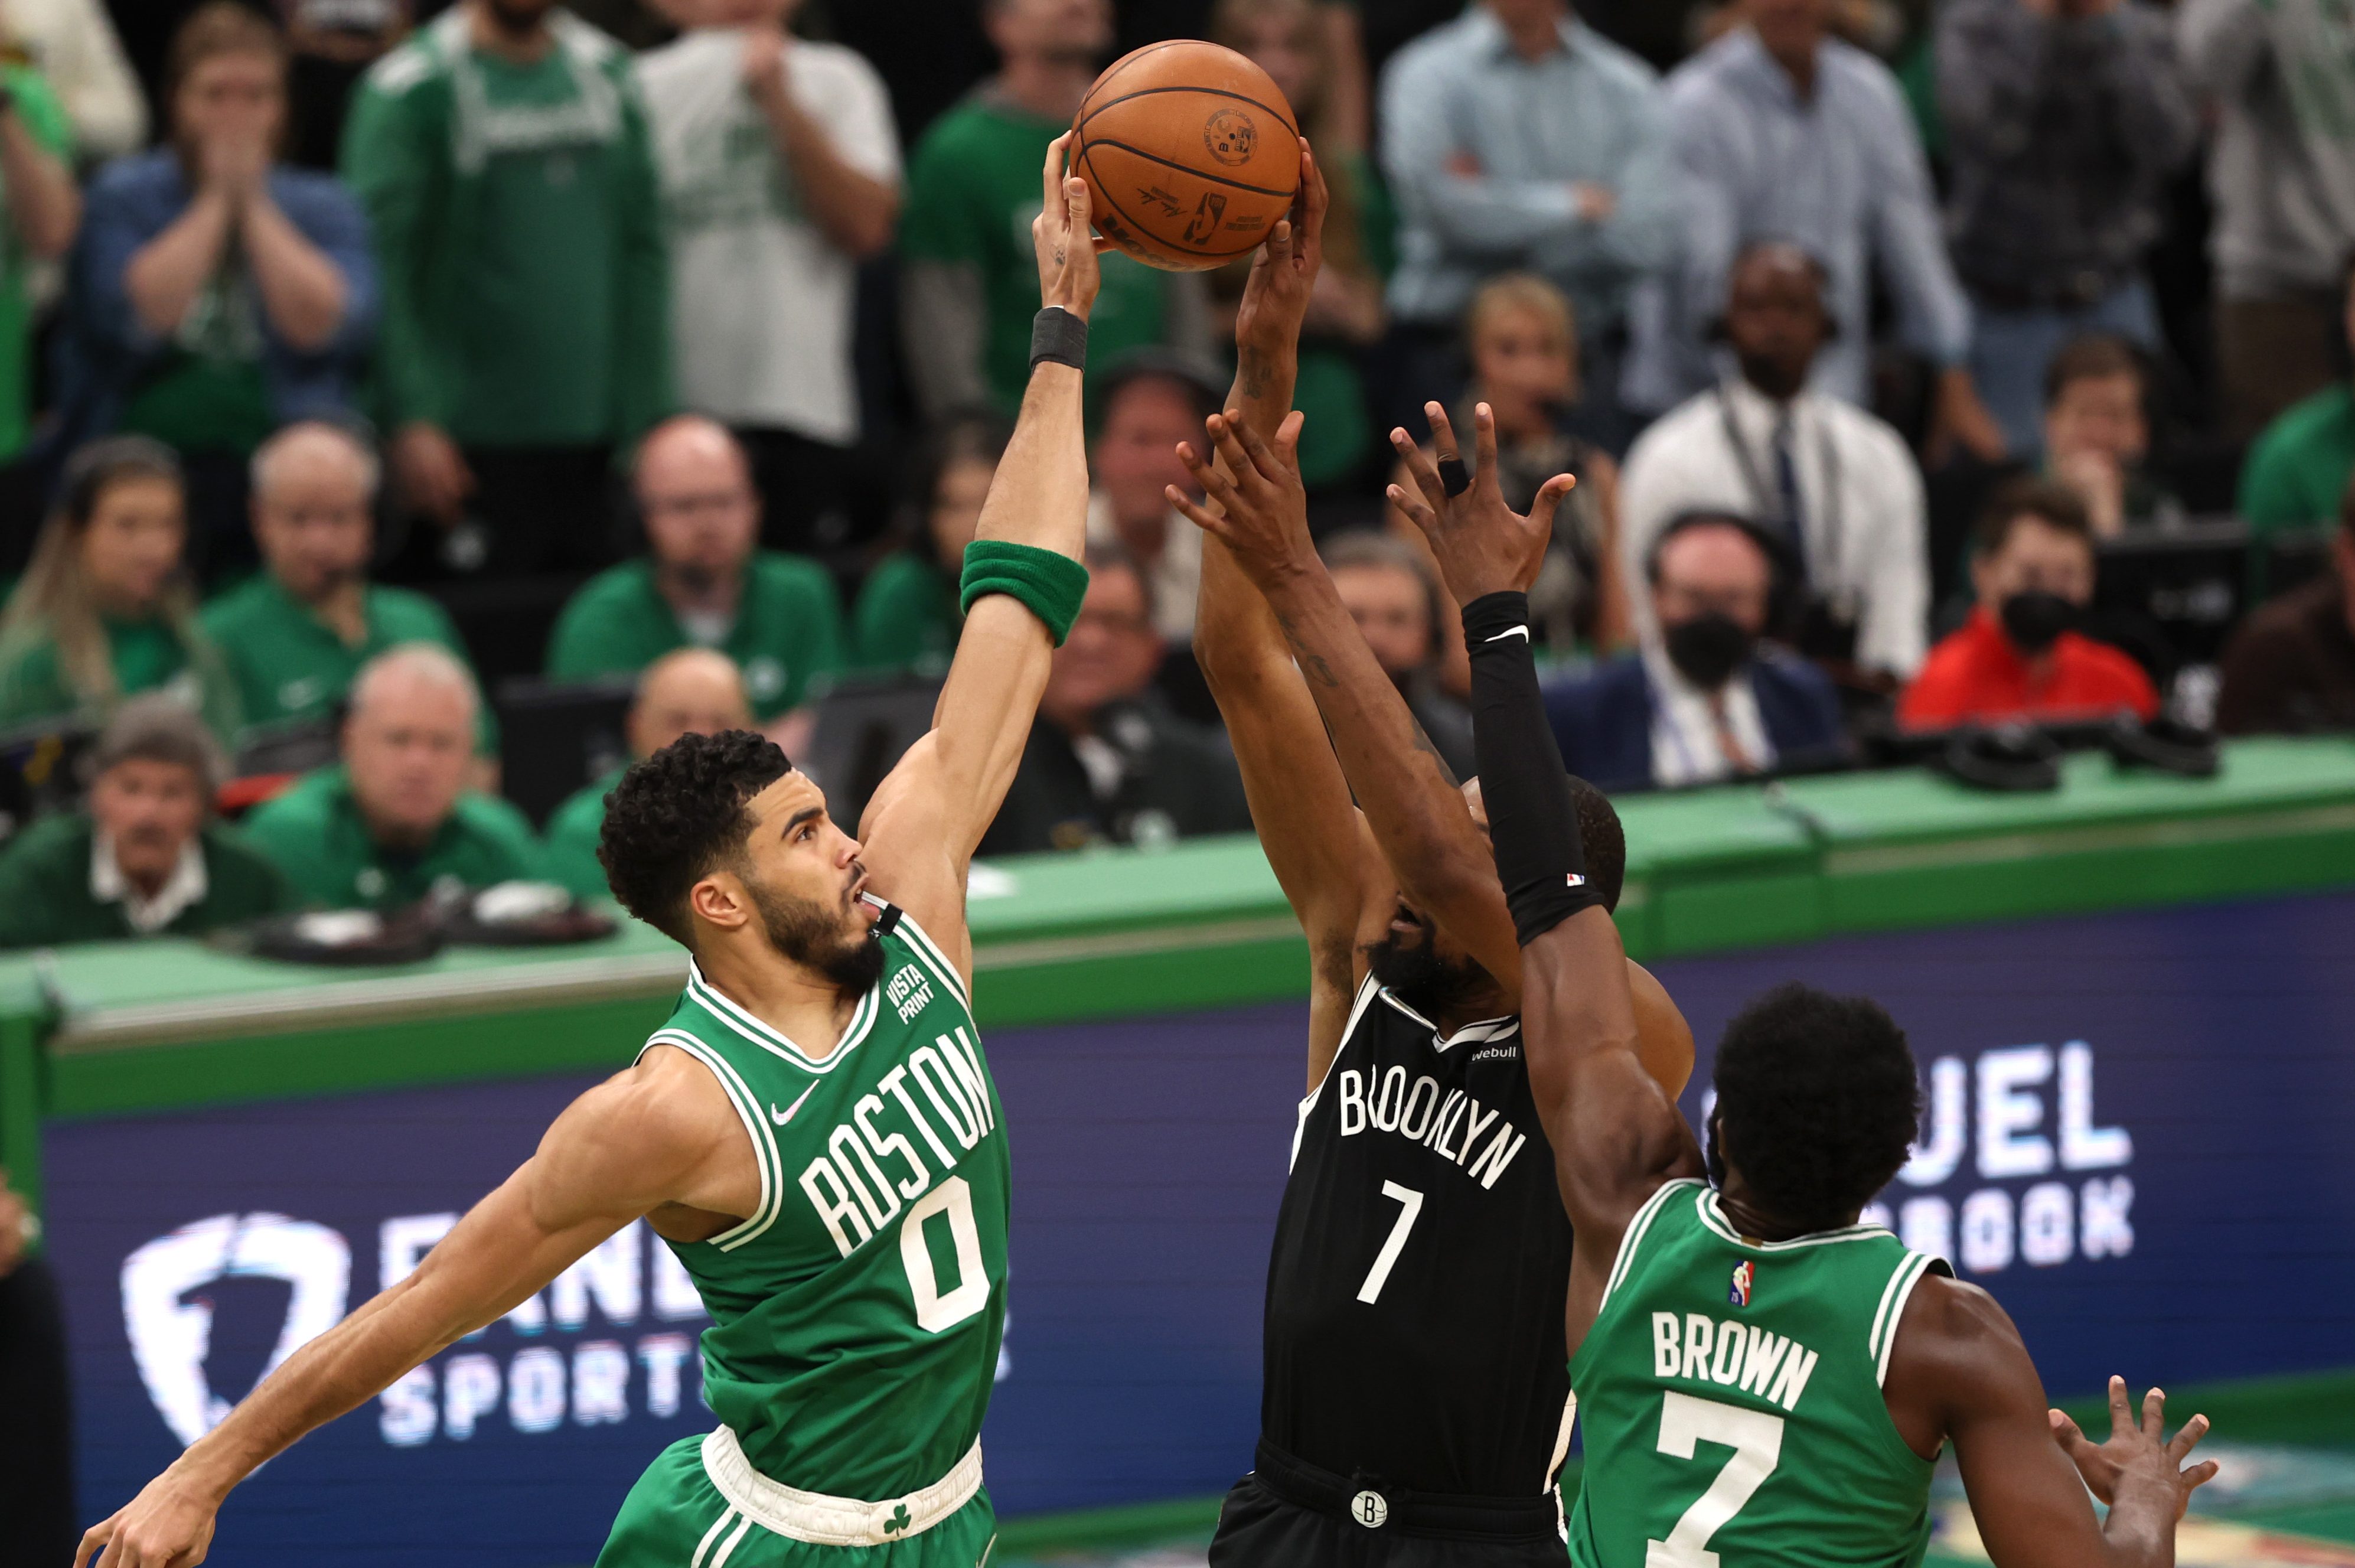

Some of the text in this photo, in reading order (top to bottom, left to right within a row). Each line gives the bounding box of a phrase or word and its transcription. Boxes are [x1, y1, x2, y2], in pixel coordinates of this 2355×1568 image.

[886, 963, 925, 1008] VISTA
[898, 981, 934, 1025] PRINT
[1472, 1046, 1516, 1061] webull
[798, 1026, 994, 1259] BOSTON
[900, 1175, 990, 1334] 0
[1356, 1179, 1424, 1305] 7
[378, 1332, 709, 1447] SPORT
[1652, 1311, 1819, 1412] BROWN
[1645, 1390, 1785, 1568] 7
